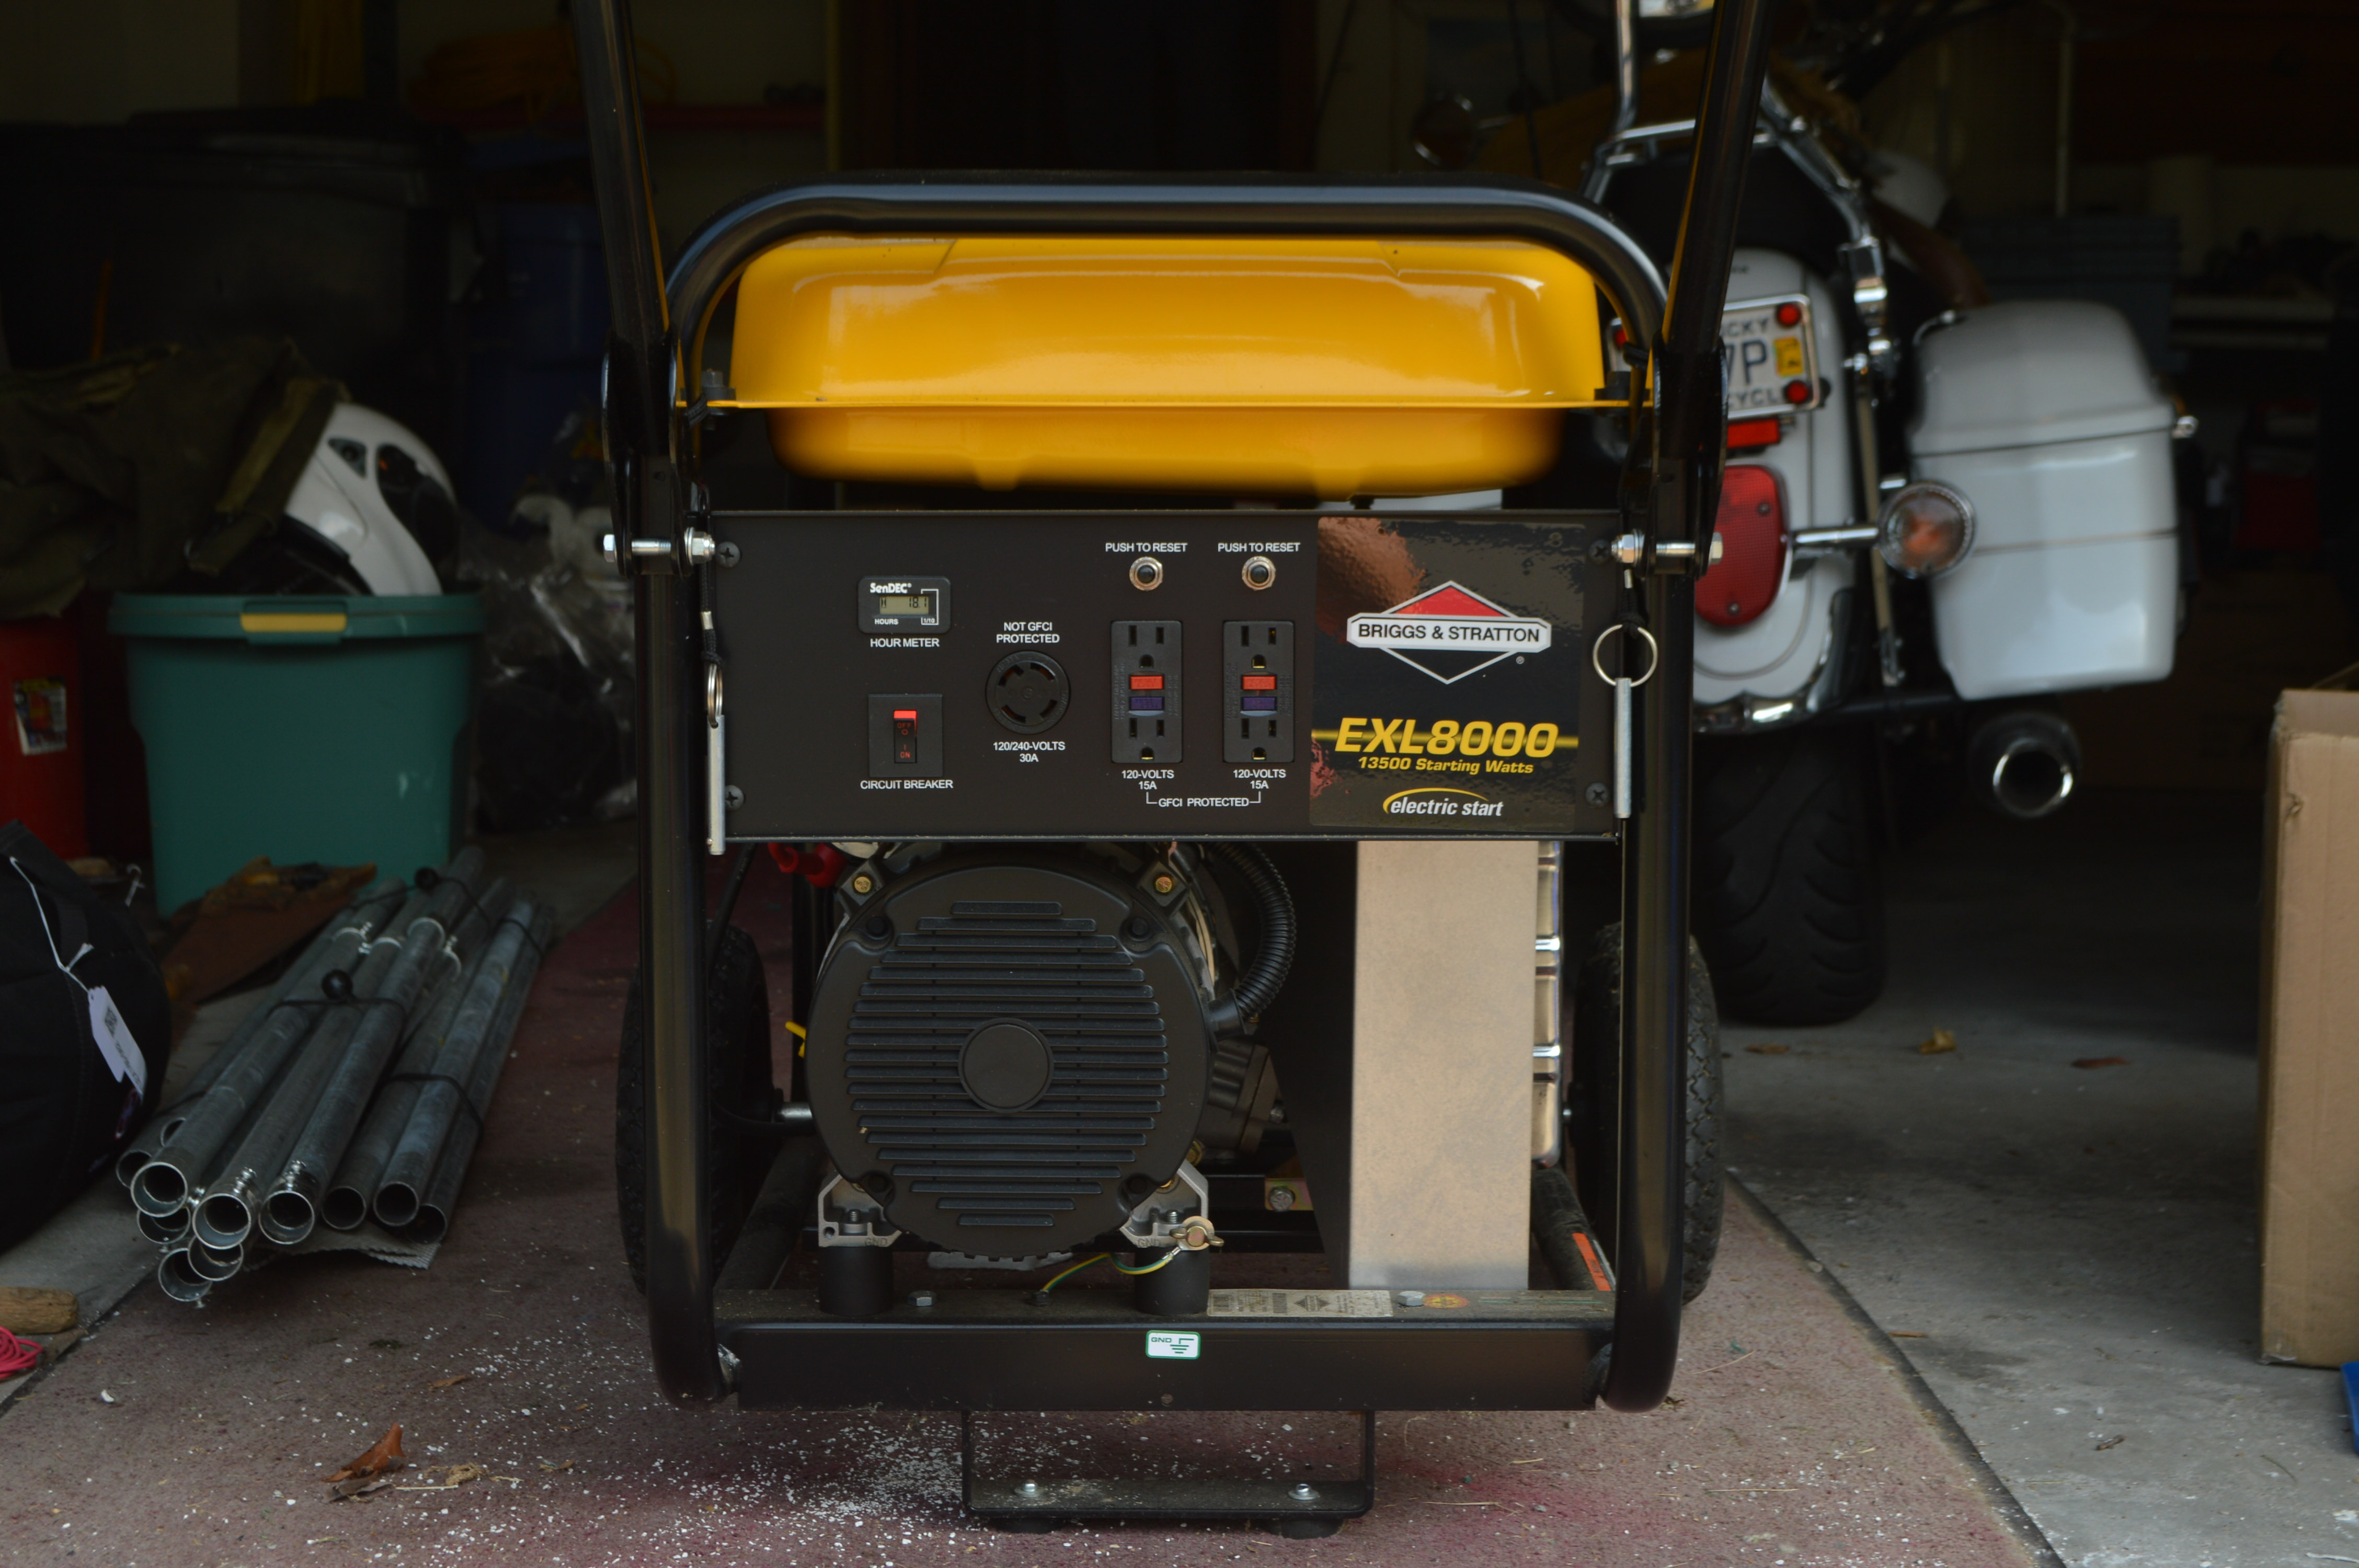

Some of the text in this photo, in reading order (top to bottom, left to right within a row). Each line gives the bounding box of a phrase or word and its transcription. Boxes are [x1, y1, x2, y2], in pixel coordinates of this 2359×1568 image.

[1105, 543, 1188, 552] PUSH TO RESET
[1218, 543, 1301, 552] PUSH TO RESET
[1004, 622, 1052, 631] NOT GFCI
[1358, 624, 1539, 642] BRIGGS & STRATTON
[870, 638, 940, 648] HOUR METER
[996, 634, 1060, 643] PROTECTED
[1335, 718, 1559, 757] EXL8000
[993, 741, 1066, 751] 120/240-VOLTS
[1020, 753, 1039, 763] 30A
[1358, 756, 1534, 775] 13500 Starting Watts
[1121, 769, 1175, 779] 120-VOLTS
[1233, 769, 1287, 778] 120-VOLTS
[860, 779, 954, 790] CIRCUIT BREAKER
[1139, 781, 1157, 790] 15A
[1250, 780, 1269, 789] 15A
[1158, 798, 1249, 807] GFCI PROTECTED
[1390, 797, 1504, 816] electric start
